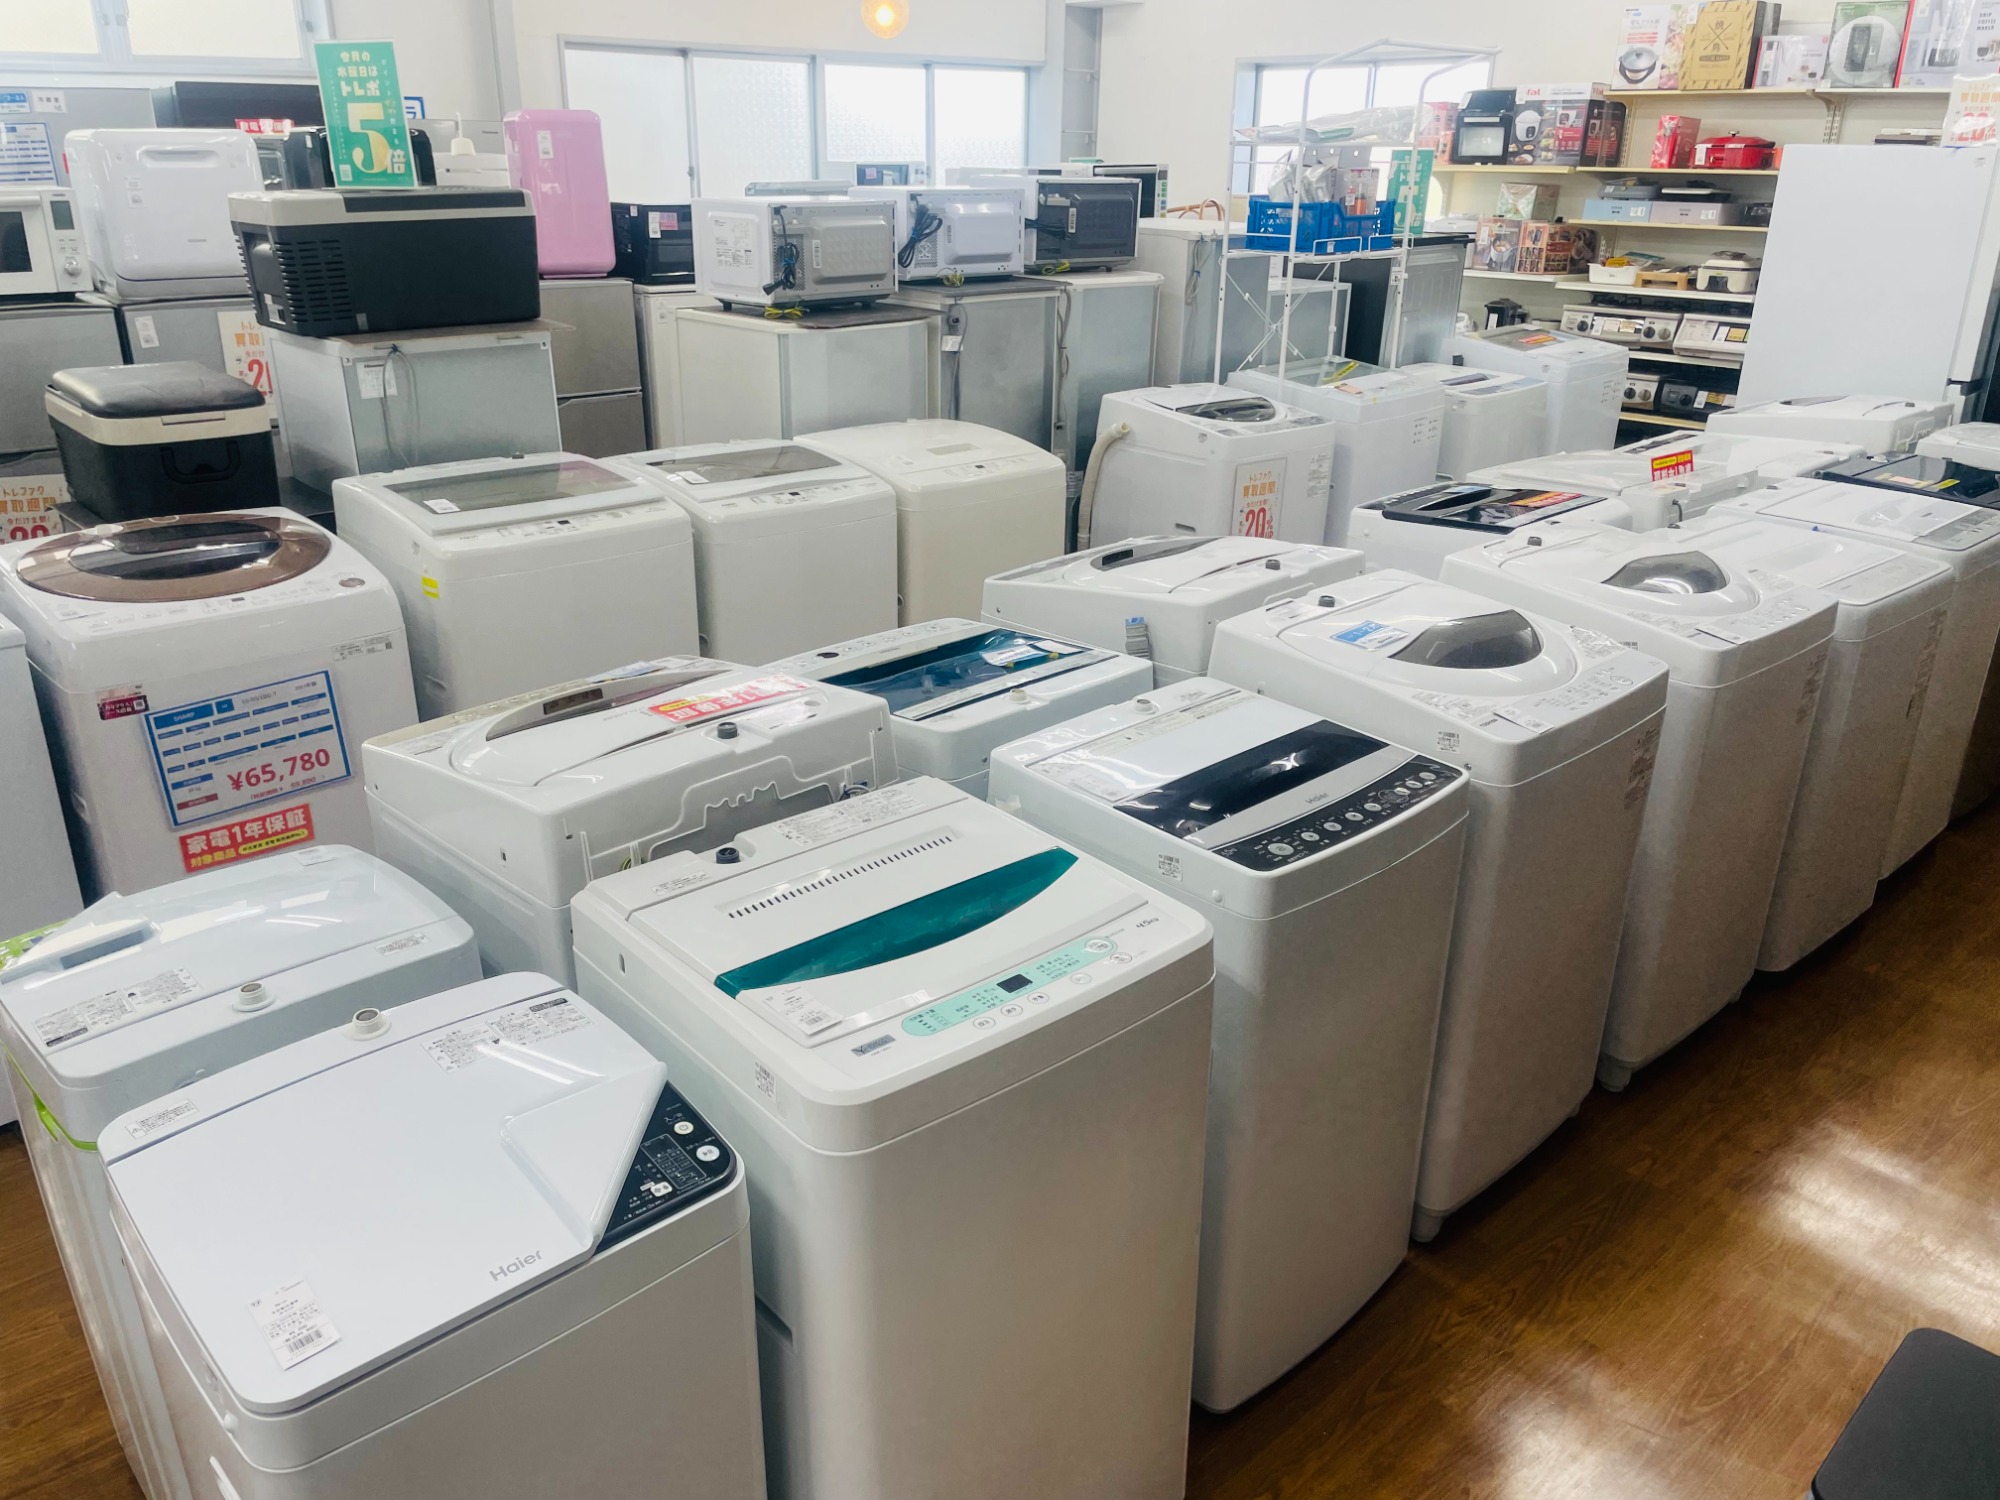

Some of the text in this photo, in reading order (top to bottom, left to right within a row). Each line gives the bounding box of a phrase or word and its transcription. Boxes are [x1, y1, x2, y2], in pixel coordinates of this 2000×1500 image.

[341, 80, 380, 97] トレポ
[387, 149, 406, 174] 倍
[3, 485, 45, 497] トレファク
[227, 748, 331, 791] ¥65,780
[185, 808, 307, 855] 家電1年保証
[190, 847, 237, 868] 対象商品
[489, 1249, 543, 1281] Haier
